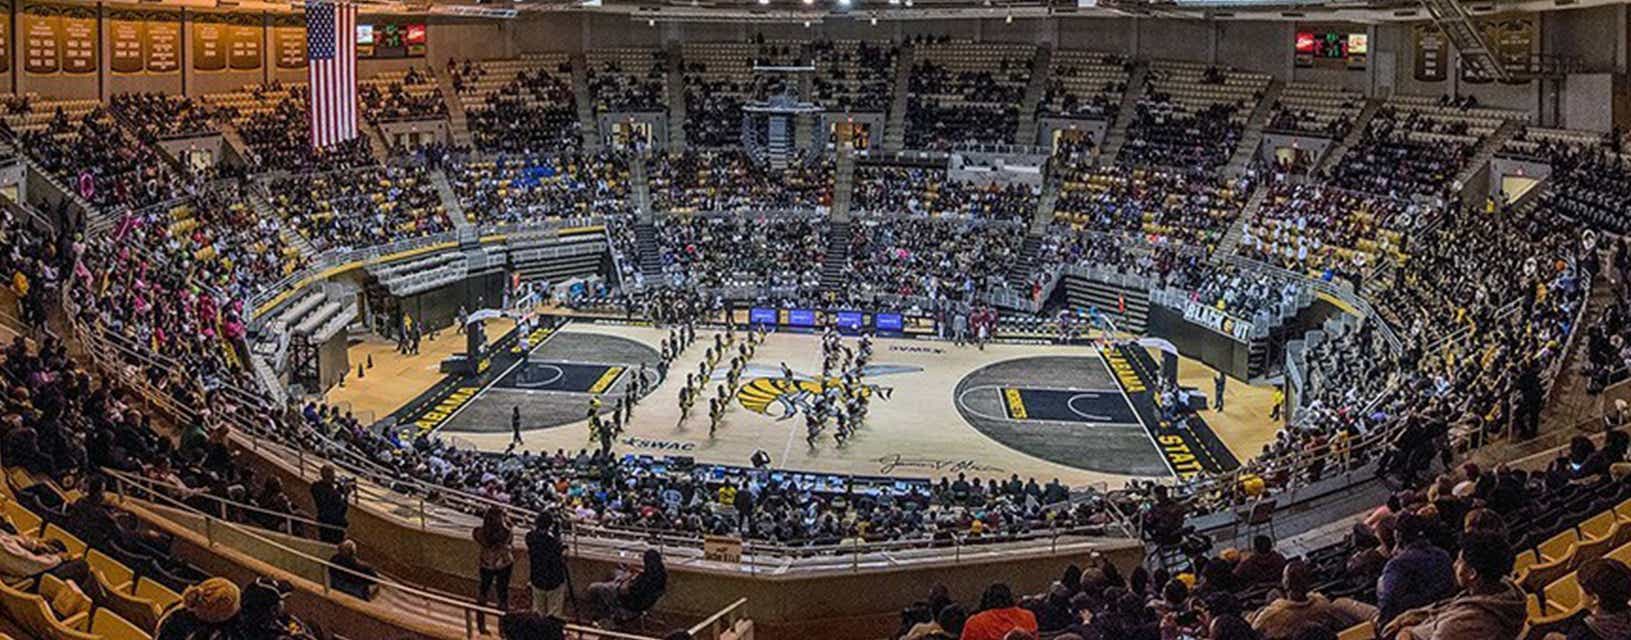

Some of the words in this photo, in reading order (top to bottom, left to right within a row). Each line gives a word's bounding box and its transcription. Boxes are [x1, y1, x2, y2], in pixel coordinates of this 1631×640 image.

[1184, 303, 1225, 329] BLACK
[414, 387, 481, 434] ABAMA
[637, 439, 696, 451] SWAC
